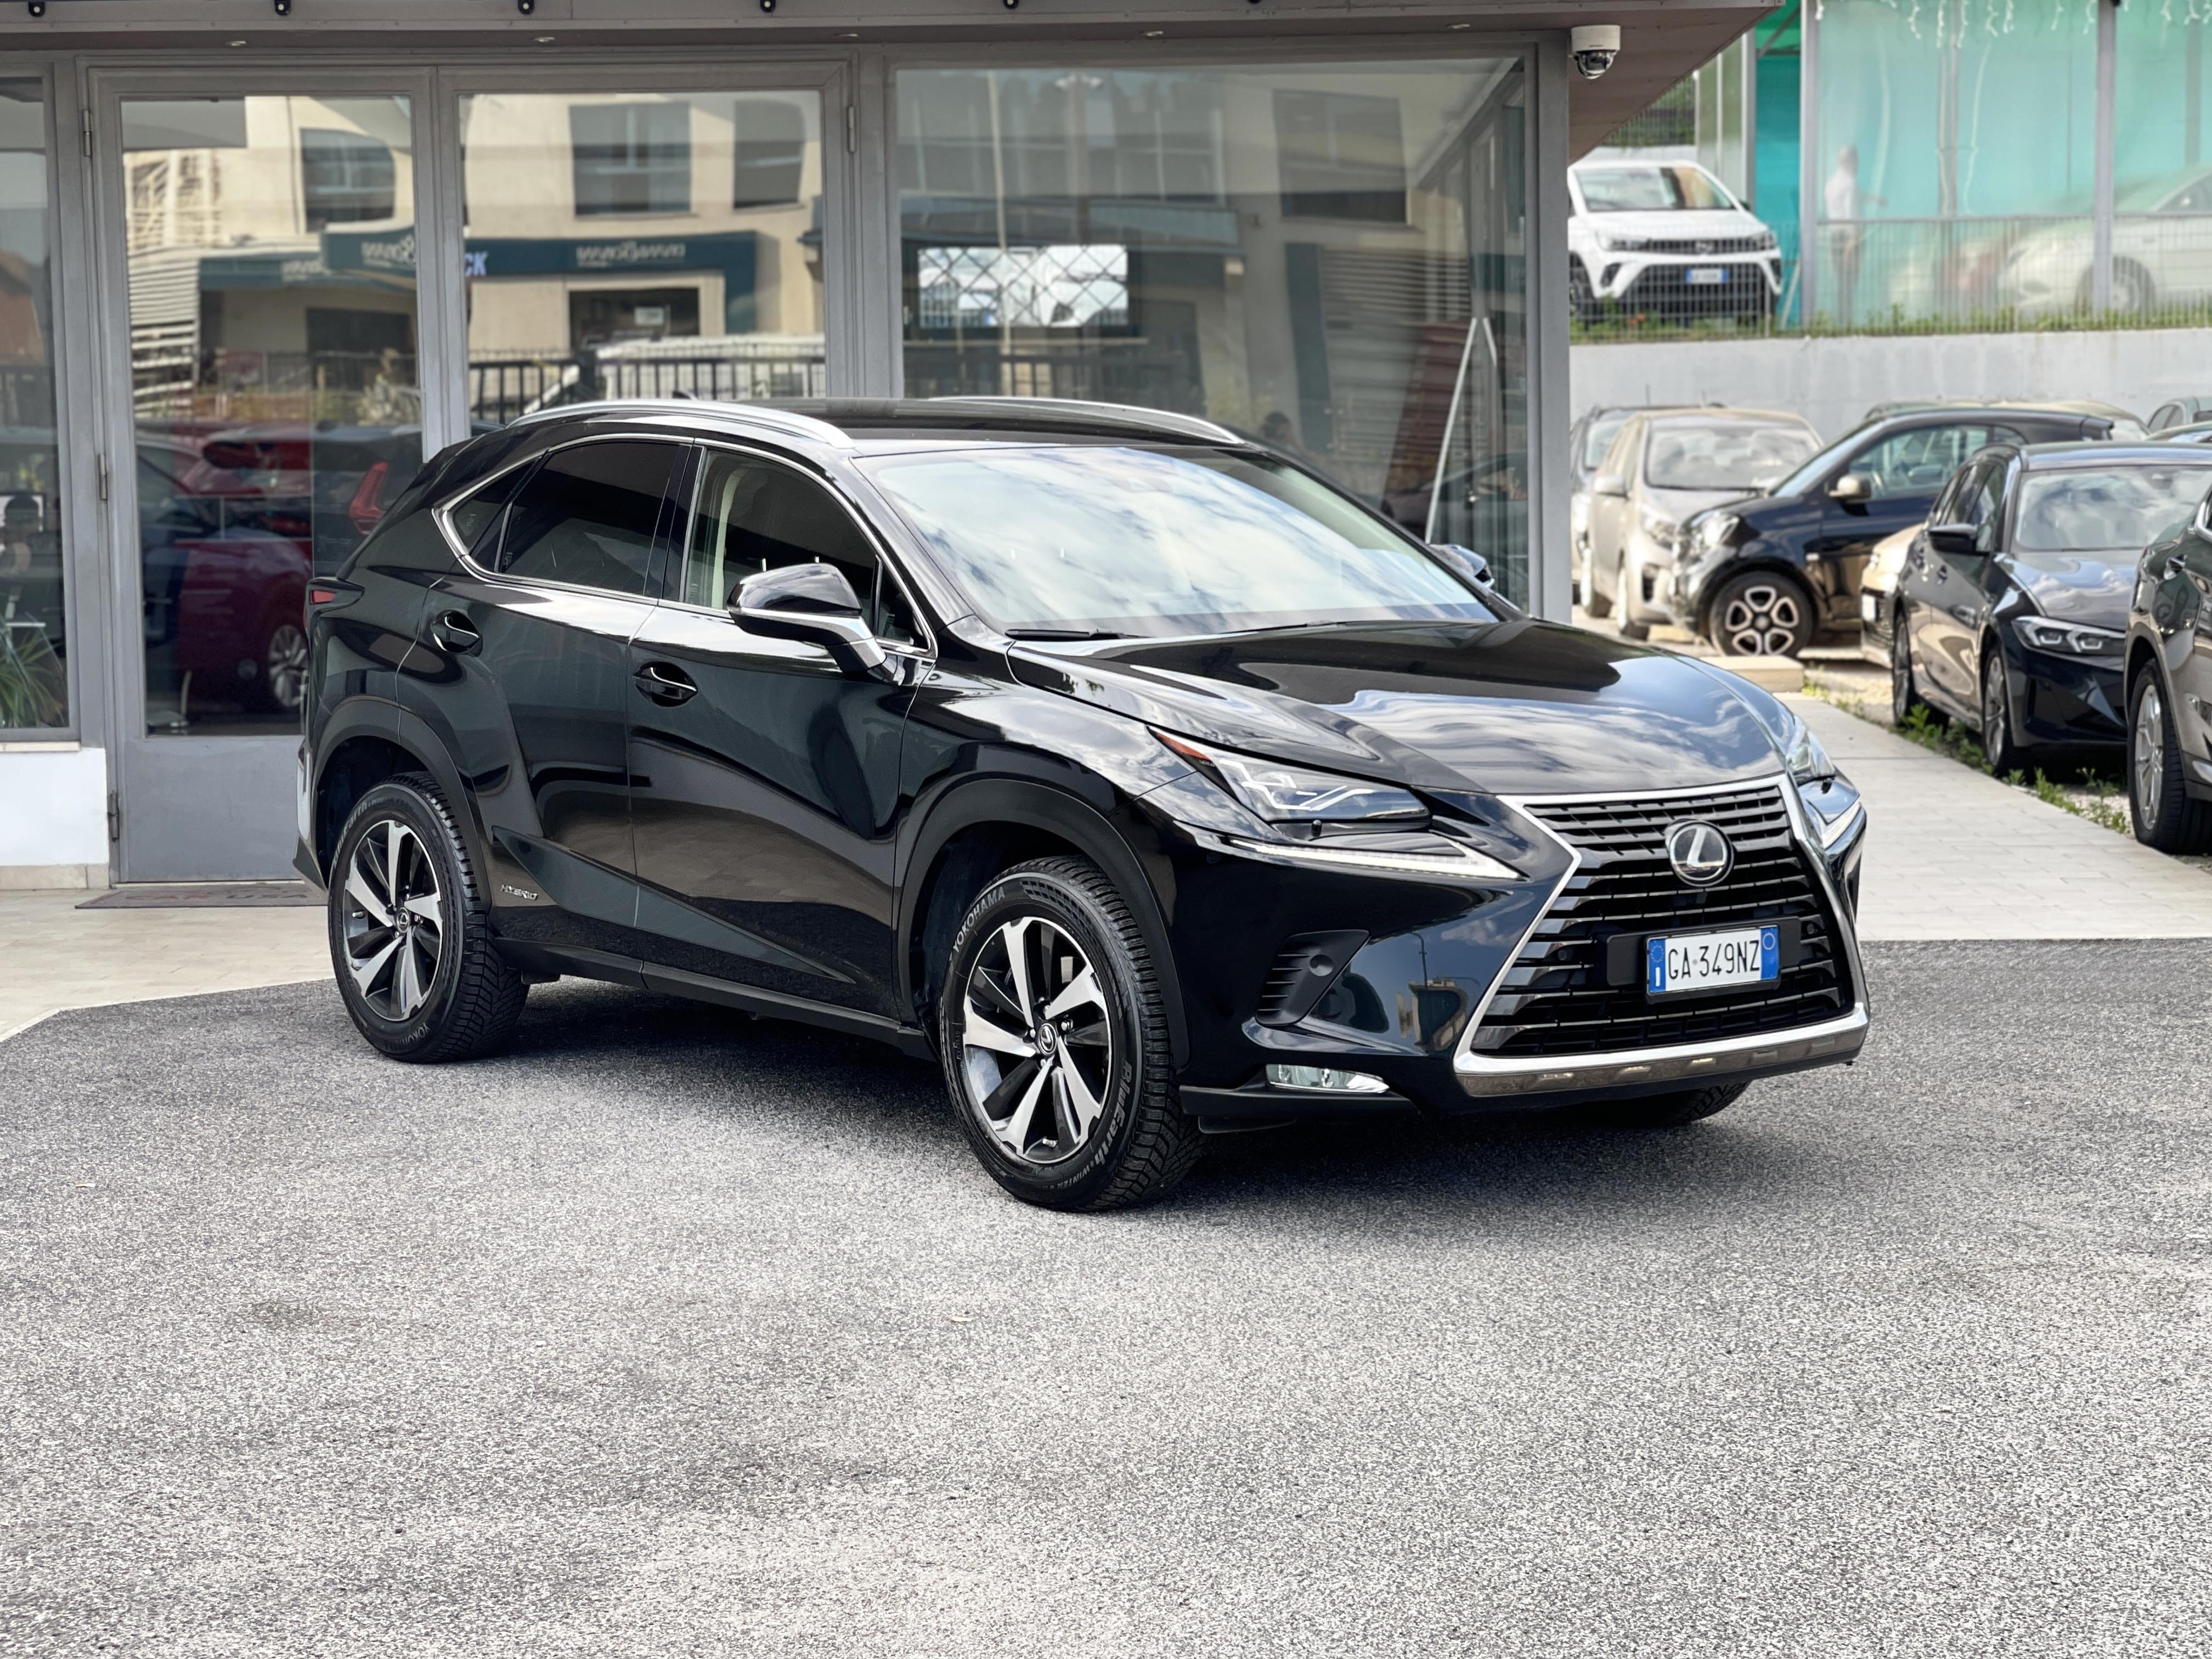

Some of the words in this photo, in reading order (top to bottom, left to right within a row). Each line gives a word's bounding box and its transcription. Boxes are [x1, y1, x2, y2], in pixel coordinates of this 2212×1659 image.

[501, 884, 538, 900] HYBRID
[952, 885, 1006, 953] YOKOHAMA
[1655, 967, 1661, 987] I
[1668, 947, 1691, 980] GA
[1699, 939, 1760, 977] 349NZ
[1094, 1057, 1132, 1166] BluEarth
